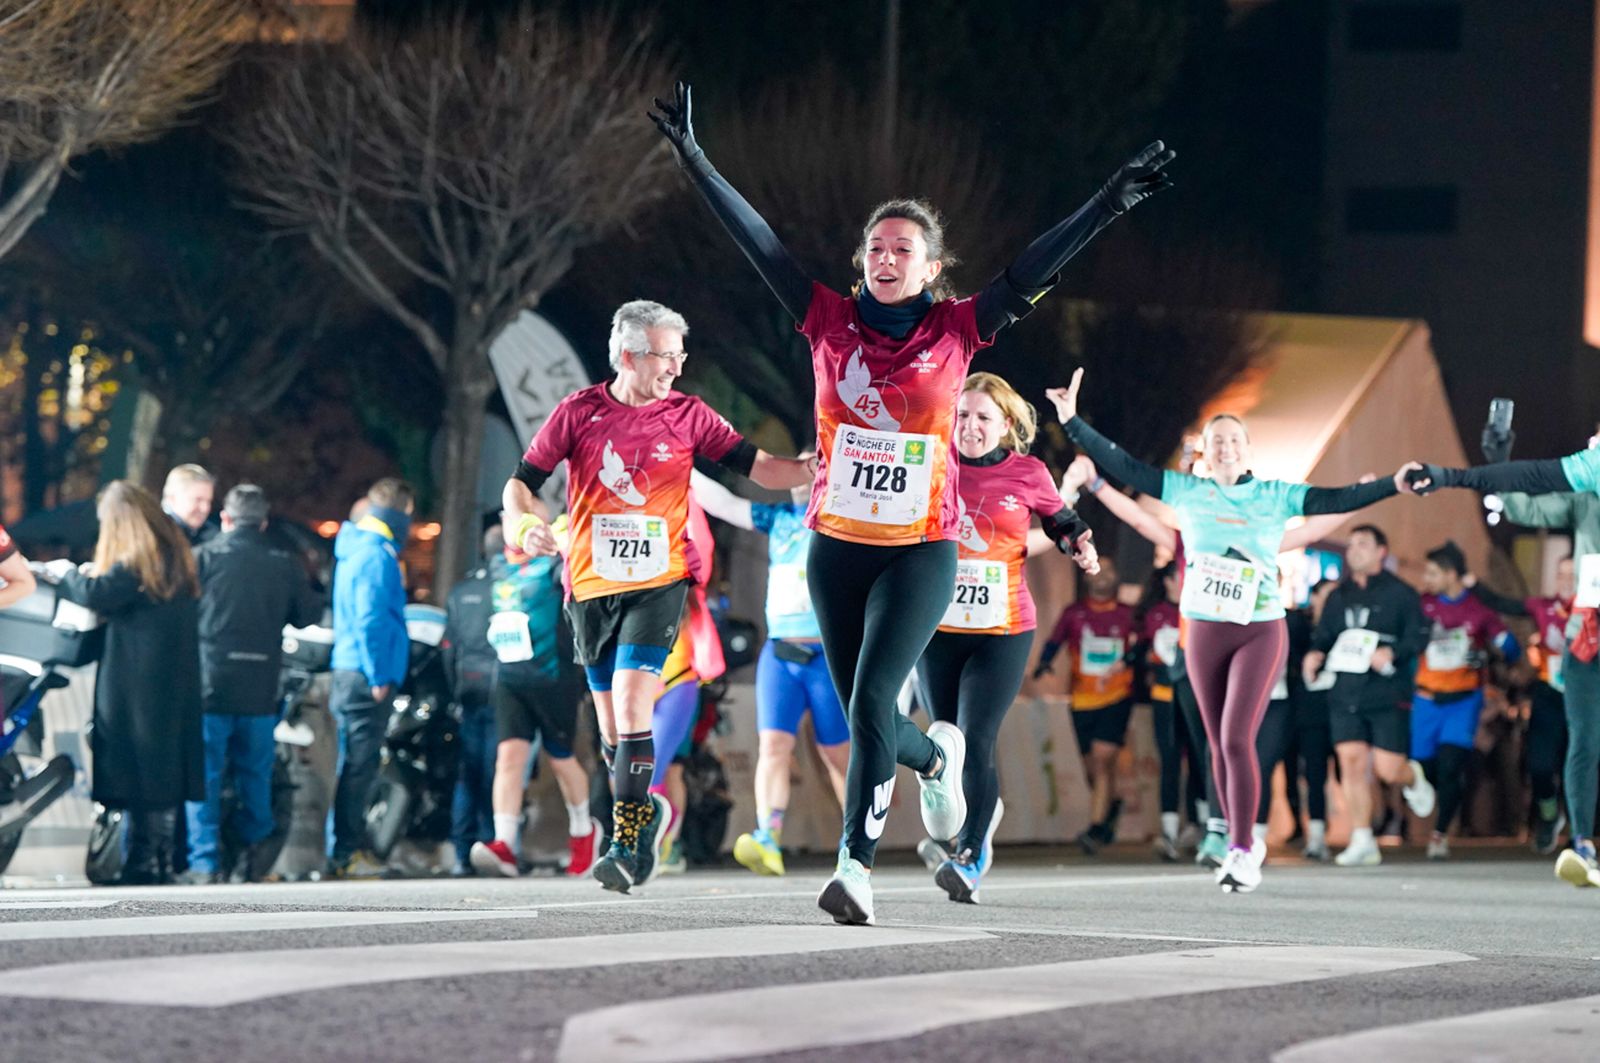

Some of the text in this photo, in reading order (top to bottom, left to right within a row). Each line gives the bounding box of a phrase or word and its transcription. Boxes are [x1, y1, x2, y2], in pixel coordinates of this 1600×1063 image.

[854, 394, 880, 419] 43
[844, 447, 861, 459] SAN
[856, 439, 882, 451] NOCHE
[885, 442, 896, 452] DE
[613, 478, 631, 494] 43
[851, 461, 907, 493] 7128
[609, 539, 651, 558] 7274
[952, 584, 989, 606] 273
[1203, 577, 1243, 601] 2166
